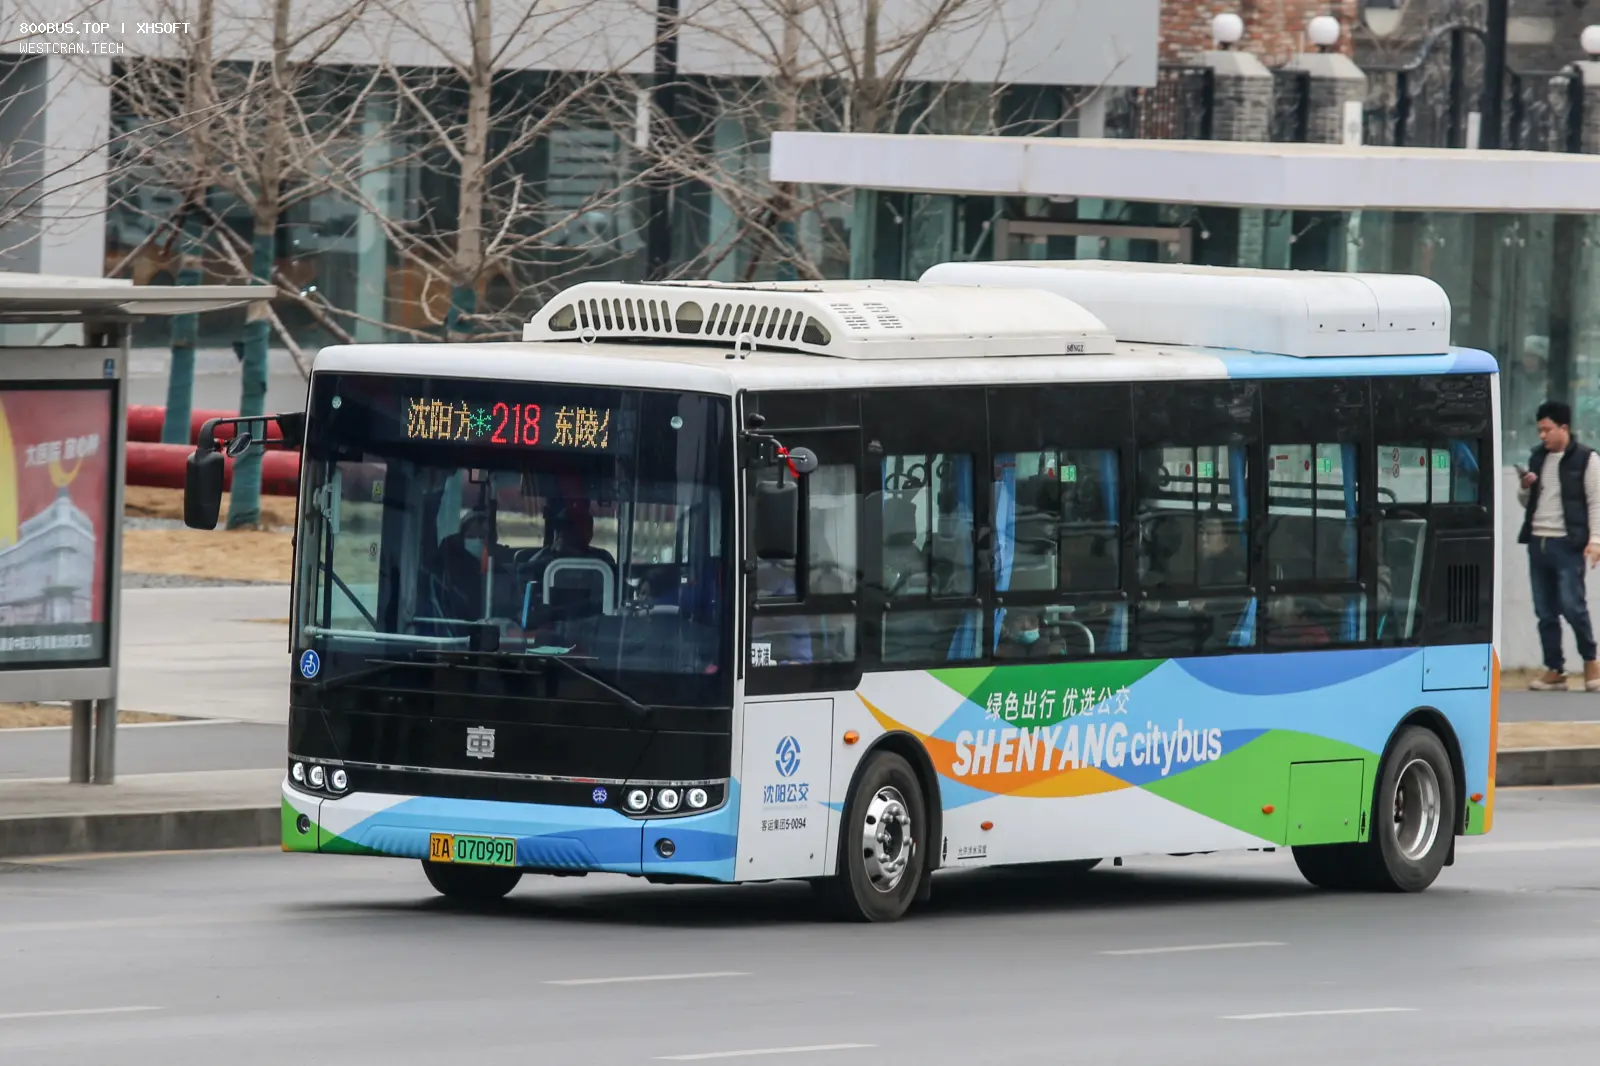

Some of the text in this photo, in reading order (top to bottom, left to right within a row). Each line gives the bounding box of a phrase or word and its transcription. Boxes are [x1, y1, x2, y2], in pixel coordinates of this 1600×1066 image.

[491, 402, 541, 445] 218
[985, 685, 1131, 722] 绿色出行 优选公交
[952, 718, 1222, 776] SHENYANG citybus
[763, 782, 809, 804] 沈阳公交
